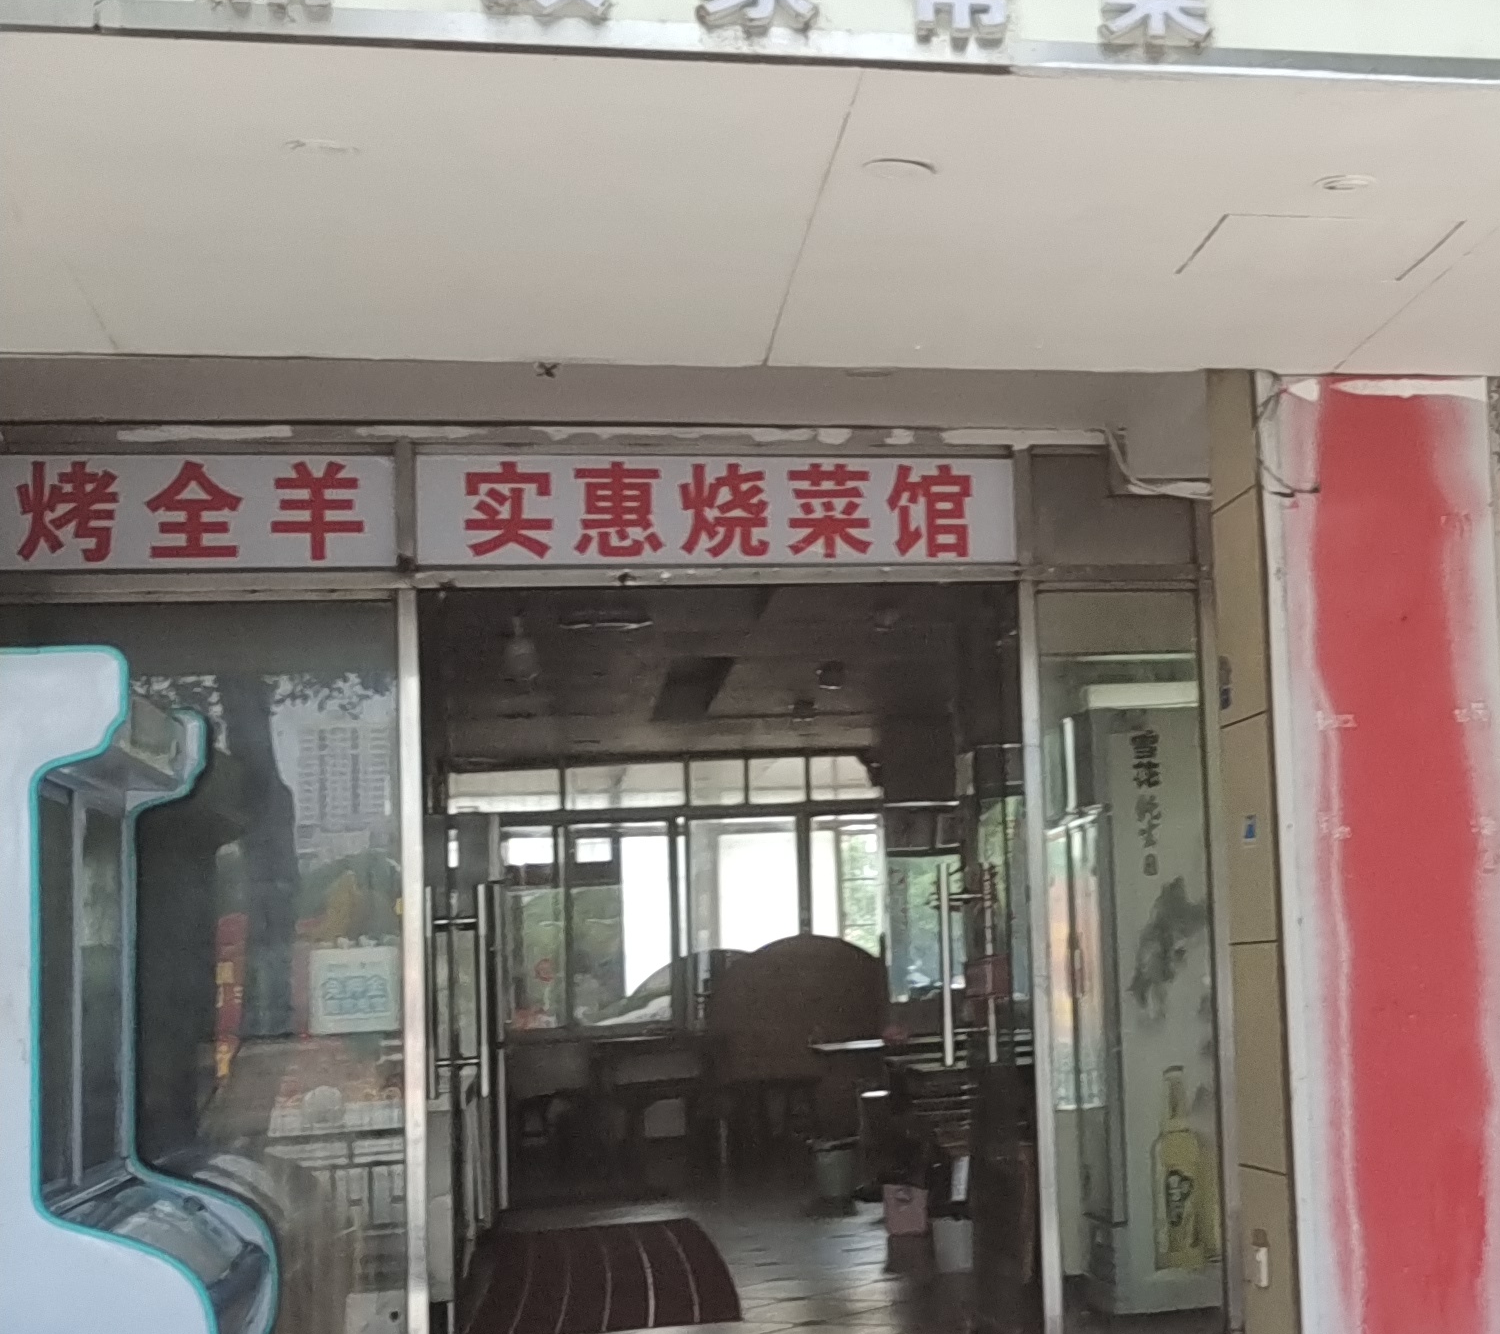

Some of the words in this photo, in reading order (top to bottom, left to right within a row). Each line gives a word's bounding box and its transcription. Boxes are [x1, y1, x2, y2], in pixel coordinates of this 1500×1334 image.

[17, 459, 366, 564] 烤全羊
[463, 460, 976, 560] 实惠烧菜馆
